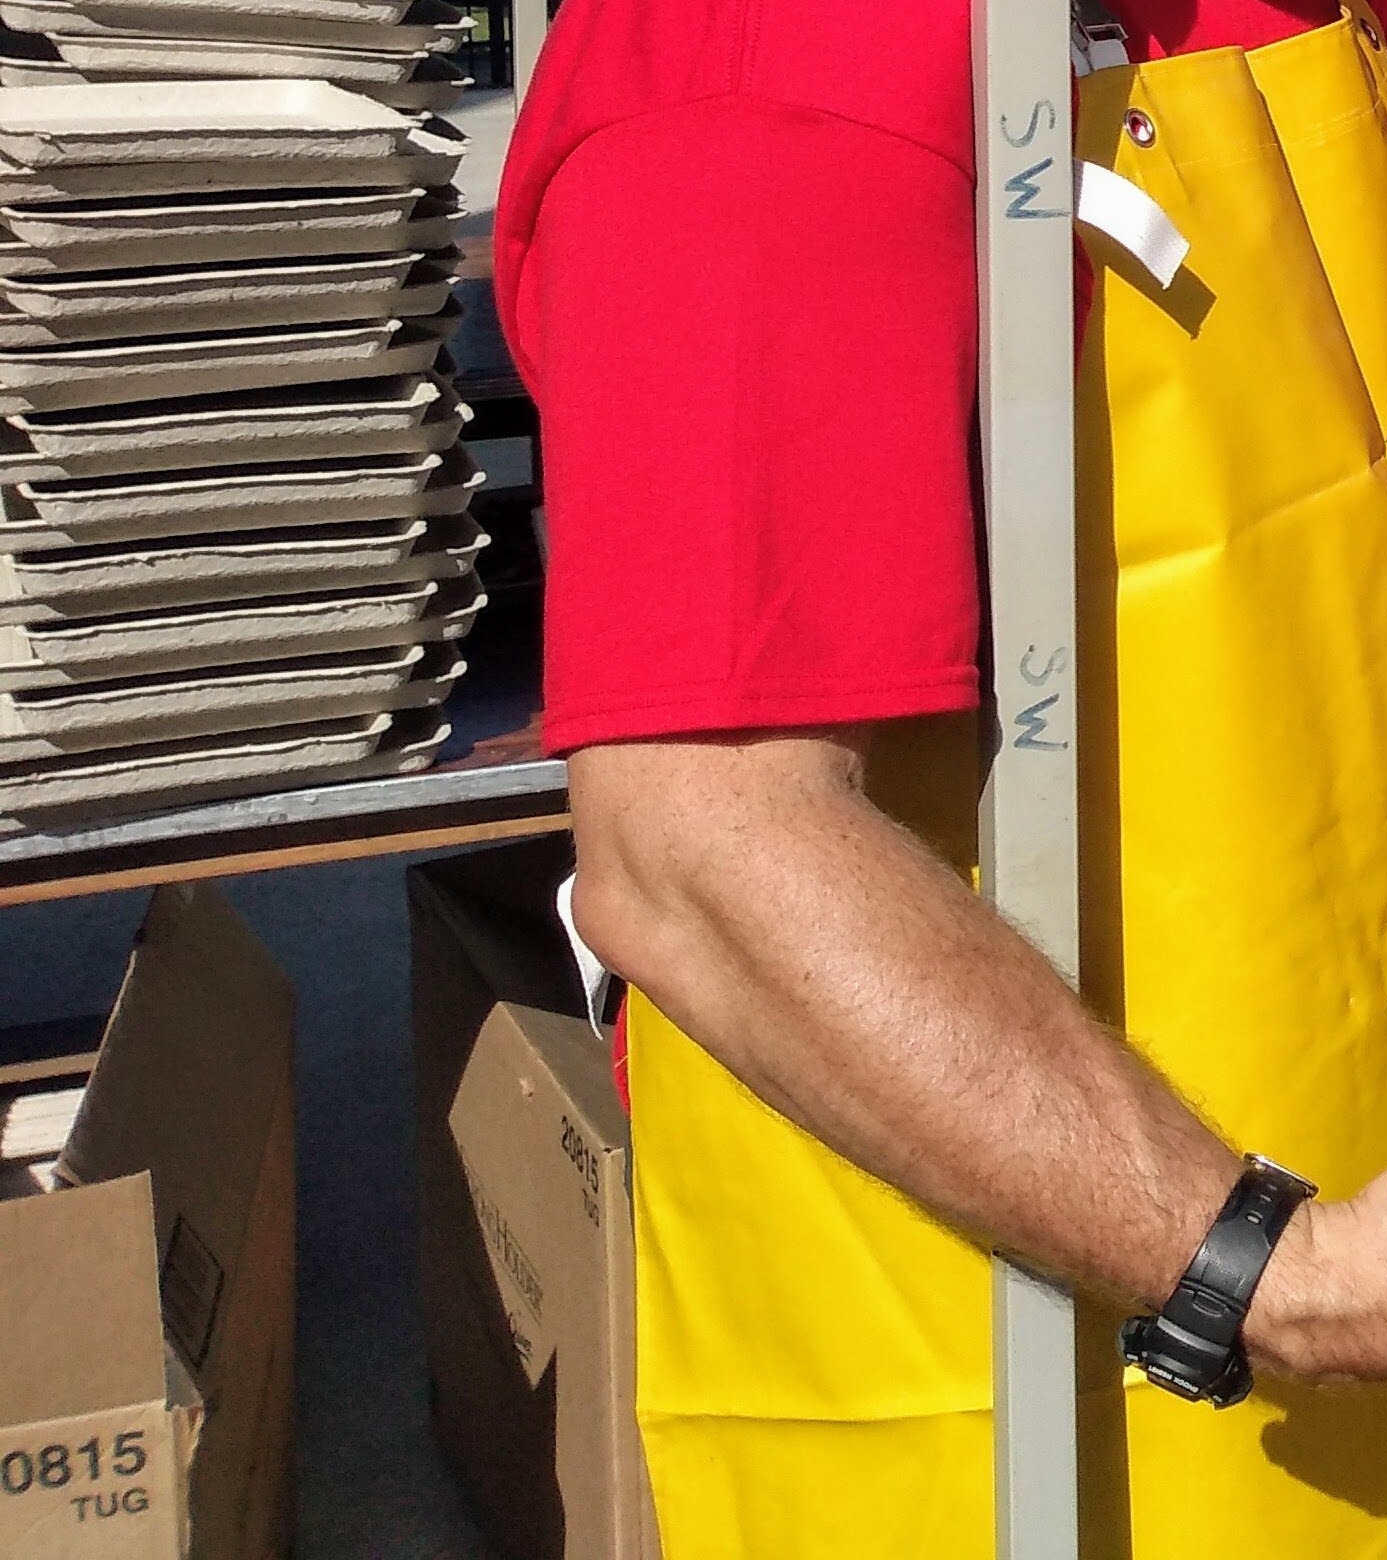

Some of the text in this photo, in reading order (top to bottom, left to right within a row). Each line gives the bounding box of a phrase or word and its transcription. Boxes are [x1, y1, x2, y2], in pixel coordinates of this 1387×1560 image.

[560, 1114, 600, 1195] 20815
[0, 1430, 147, 1495] 0815
[70, 1486, 149, 1522] TUG
